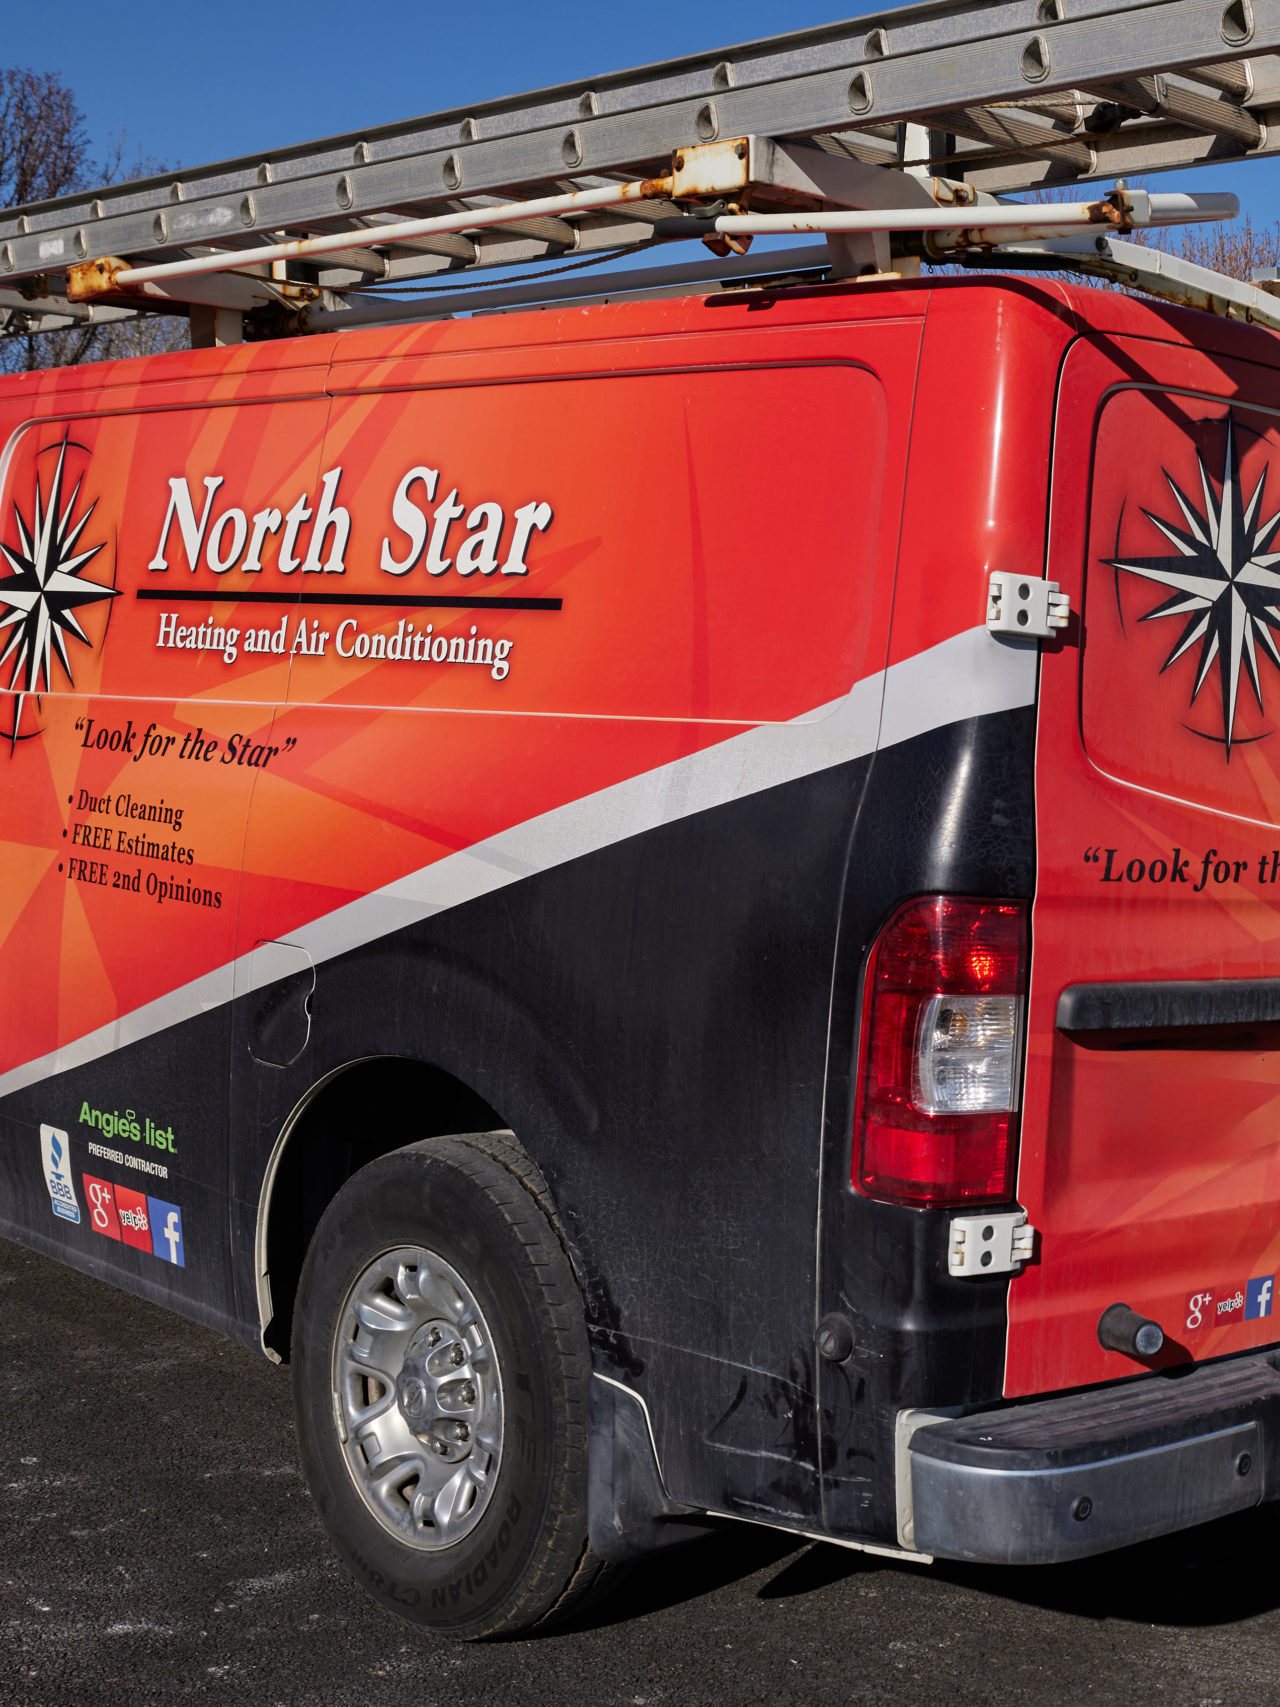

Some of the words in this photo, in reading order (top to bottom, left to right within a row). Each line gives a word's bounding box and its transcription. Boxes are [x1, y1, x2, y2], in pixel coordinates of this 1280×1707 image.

[148, 466, 353, 575] North
[380, 466, 555, 577] Star
[156, 613, 240, 664] Heating
[244, 616, 288, 655] and
[289, 617, 331, 656] Air
[335, 620, 513, 680] Conditioning
[133, 723, 176, 762] for
[179, 728, 218, 762] the
[77, 789, 111, 815] Duct
[115, 794, 184, 831] Cleaning
[72, 824, 112, 851] FREE
[116, 831, 195, 865] Estimates
[67, 858, 108, 886] FREE
[112, 869, 141, 893] 2nd
[146, 873, 222, 909] Opinions
[1193, 849, 1247, 892] for
[146, 1117, 176, 1153] list
[88, 1142, 124, 1165] PREFERRED
[125, 1154, 168, 1179] CONTRACTOR
[50, 1180, 72, 1200] BBB
[119, 1208, 139, 1230] yelp
[1217, 1298, 1236, 1315] yelp
